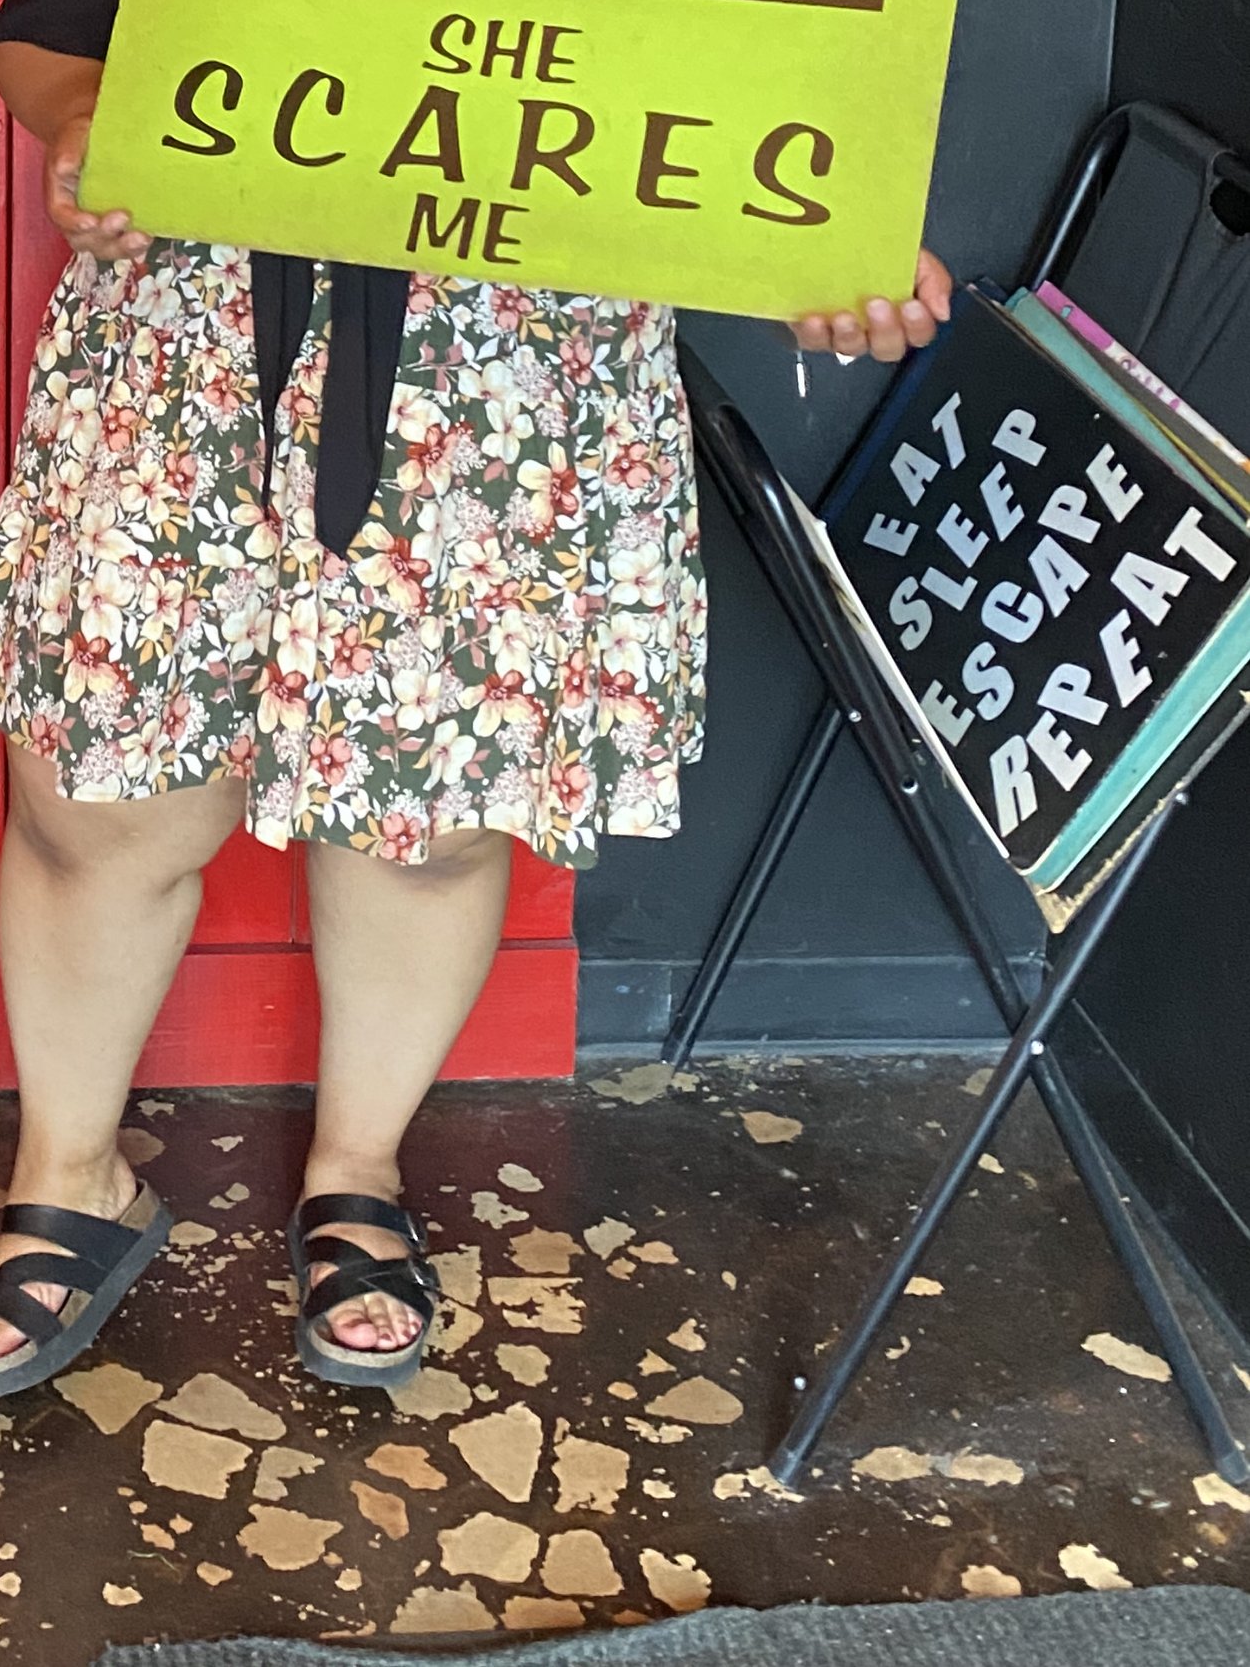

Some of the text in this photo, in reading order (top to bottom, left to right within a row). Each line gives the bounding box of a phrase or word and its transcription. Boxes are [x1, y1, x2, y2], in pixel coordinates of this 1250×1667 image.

[423, 14, 584, 84] SHE
[162, 61, 834, 226] SCARES
[406, 193, 528, 265] ME
[864, 392, 967, 555] EAT
[890, 408, 1047, 650] SLEEP
[921, 443, 1144, 746] ESCAPE
[989, 506, 1237, 836] REPEAT
